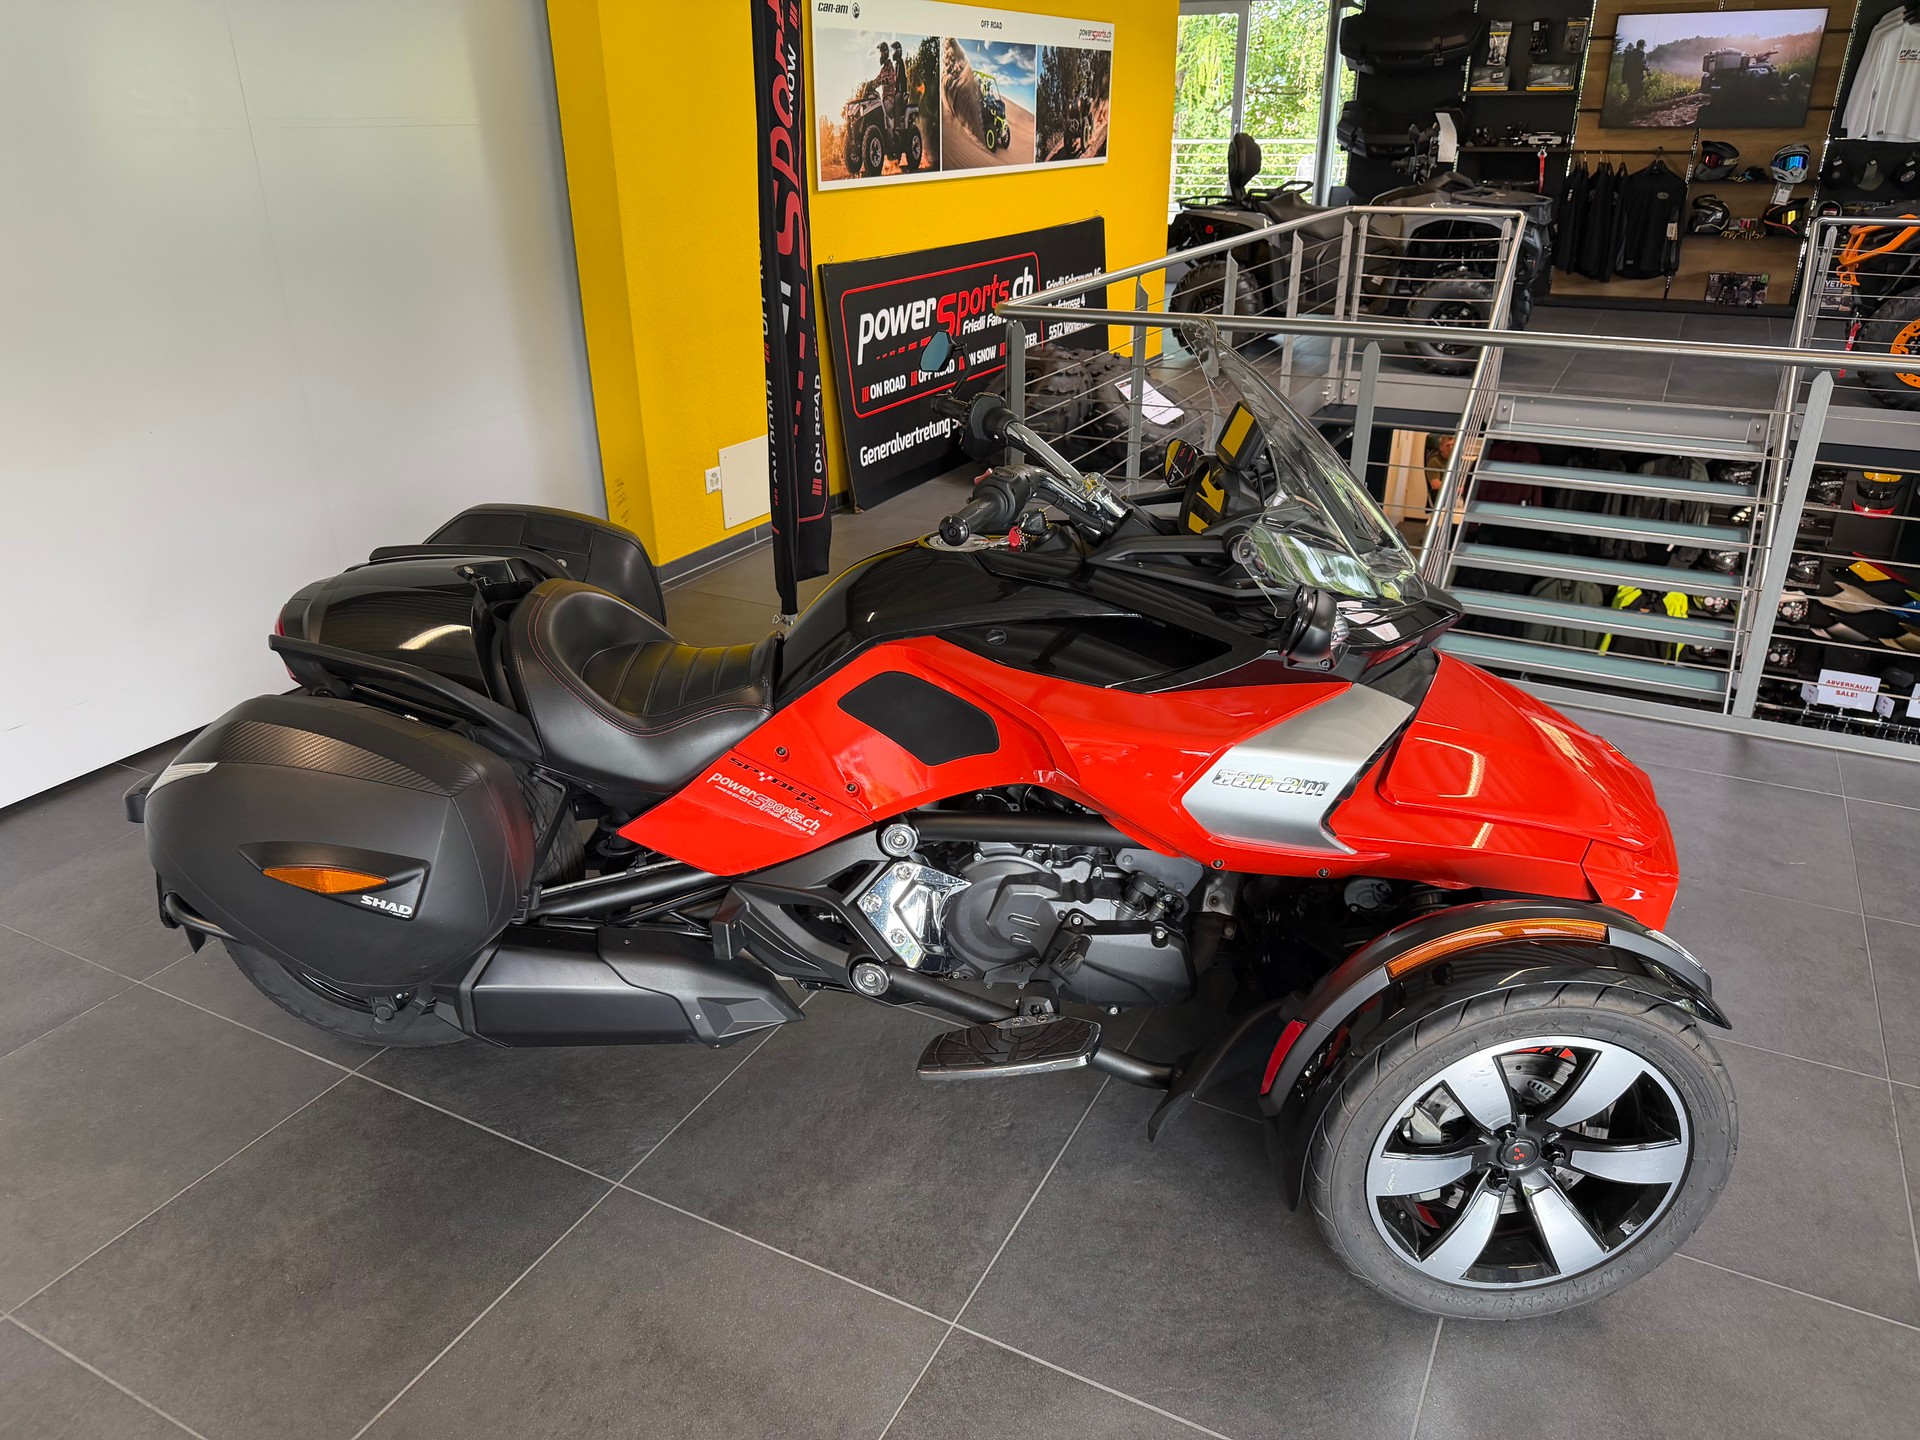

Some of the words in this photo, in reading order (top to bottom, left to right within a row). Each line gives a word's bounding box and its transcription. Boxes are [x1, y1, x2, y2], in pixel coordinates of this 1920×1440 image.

[818, 2, 849, 14] can-am
[980, 20, 990, 29] OFF
[990, 20, 1002, 29] ROAD
[787, 43, 797, 125] NOW
[1080, 293, 1086, 307] 4
[962, 315, 986, 336] Friedli
[1048, 322, 1064, 340] 5512
[1024, 332, 1038, 349] TER
[976, 345, 997, 364] SNOW
[870, 382, 883, 400] ON
[884, 374, 906, 395] ROAD
[813, 374, 822, 436] ROAD
[860, 417, 951, 468] Generalvertretung
[814, 443, 823, 474] ON
[1825, 679, 1873, 692] ABVERKAUF!
[1835, 689, 1859, 699] SALE!
[1211, 768, 1330, 797] can-am
[360, 895, 413, 915] SHAD
